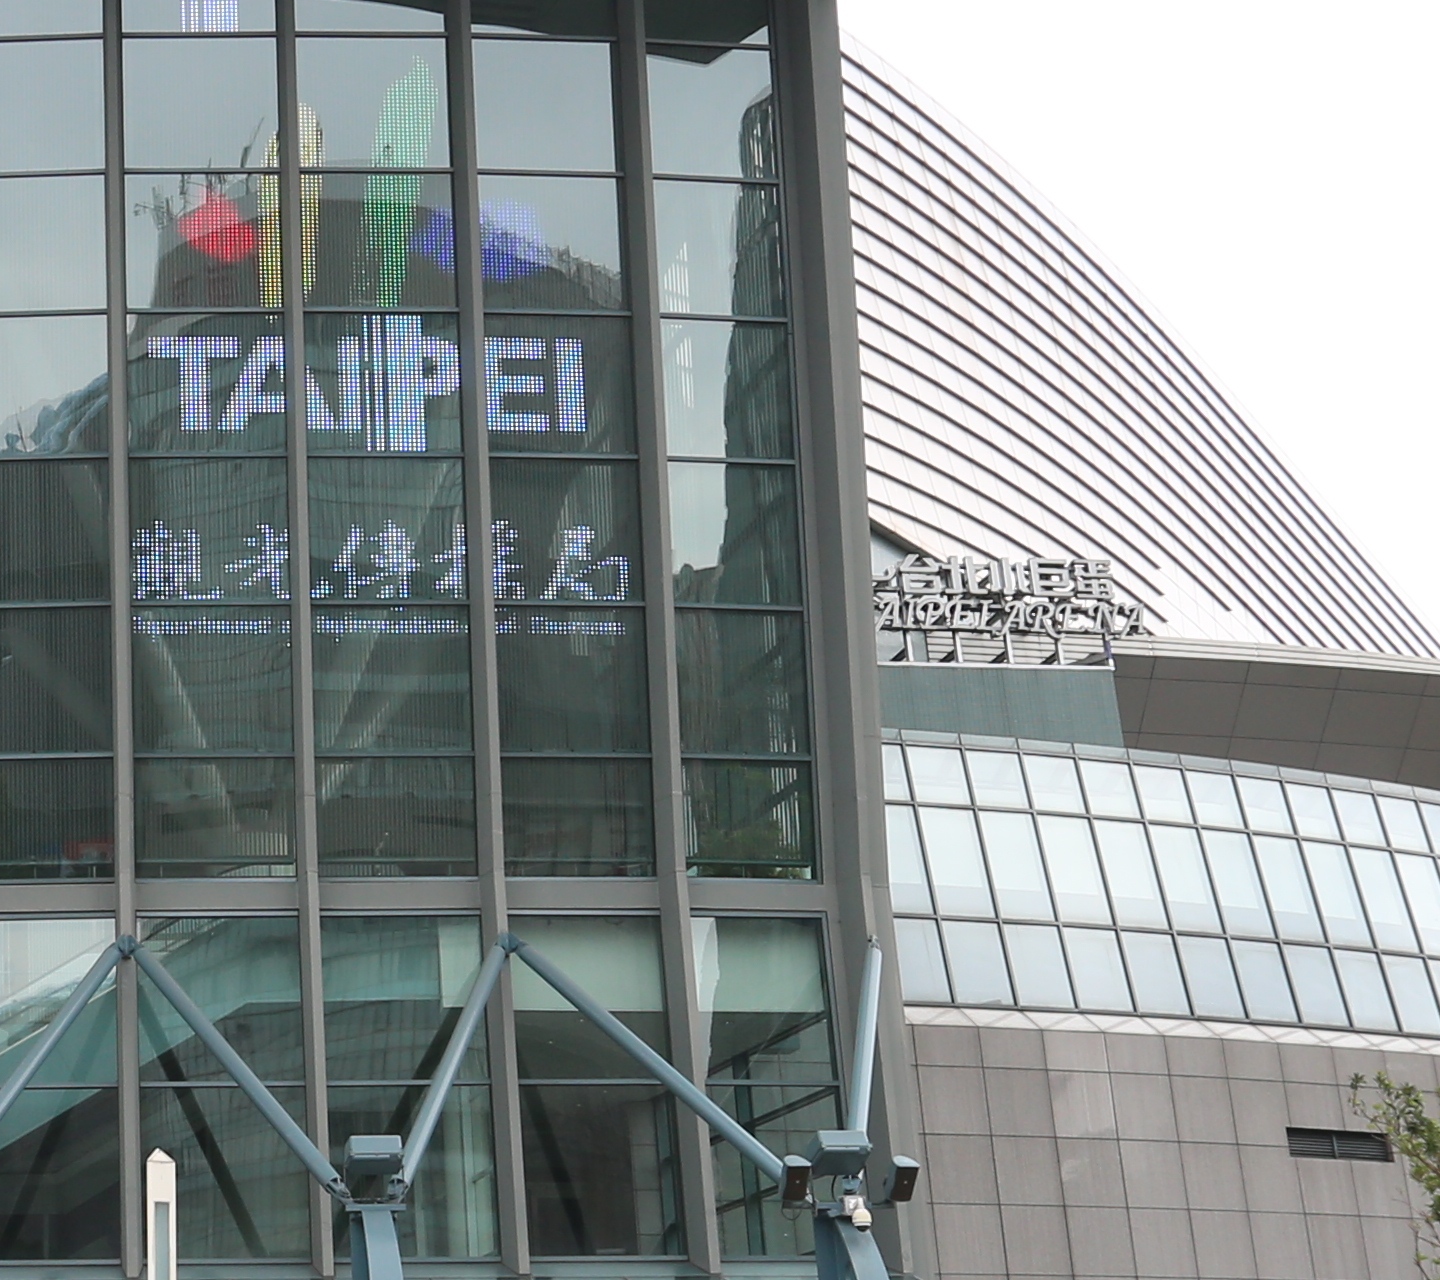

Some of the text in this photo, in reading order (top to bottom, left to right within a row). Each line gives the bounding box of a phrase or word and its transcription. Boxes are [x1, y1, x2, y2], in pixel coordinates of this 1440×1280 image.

[148, 315, 586, 453] TAIPEI
[899, 553, 1115, 601] 台北小巨蛋
[874, 598, 1149, 640] AIPEI ARENA
